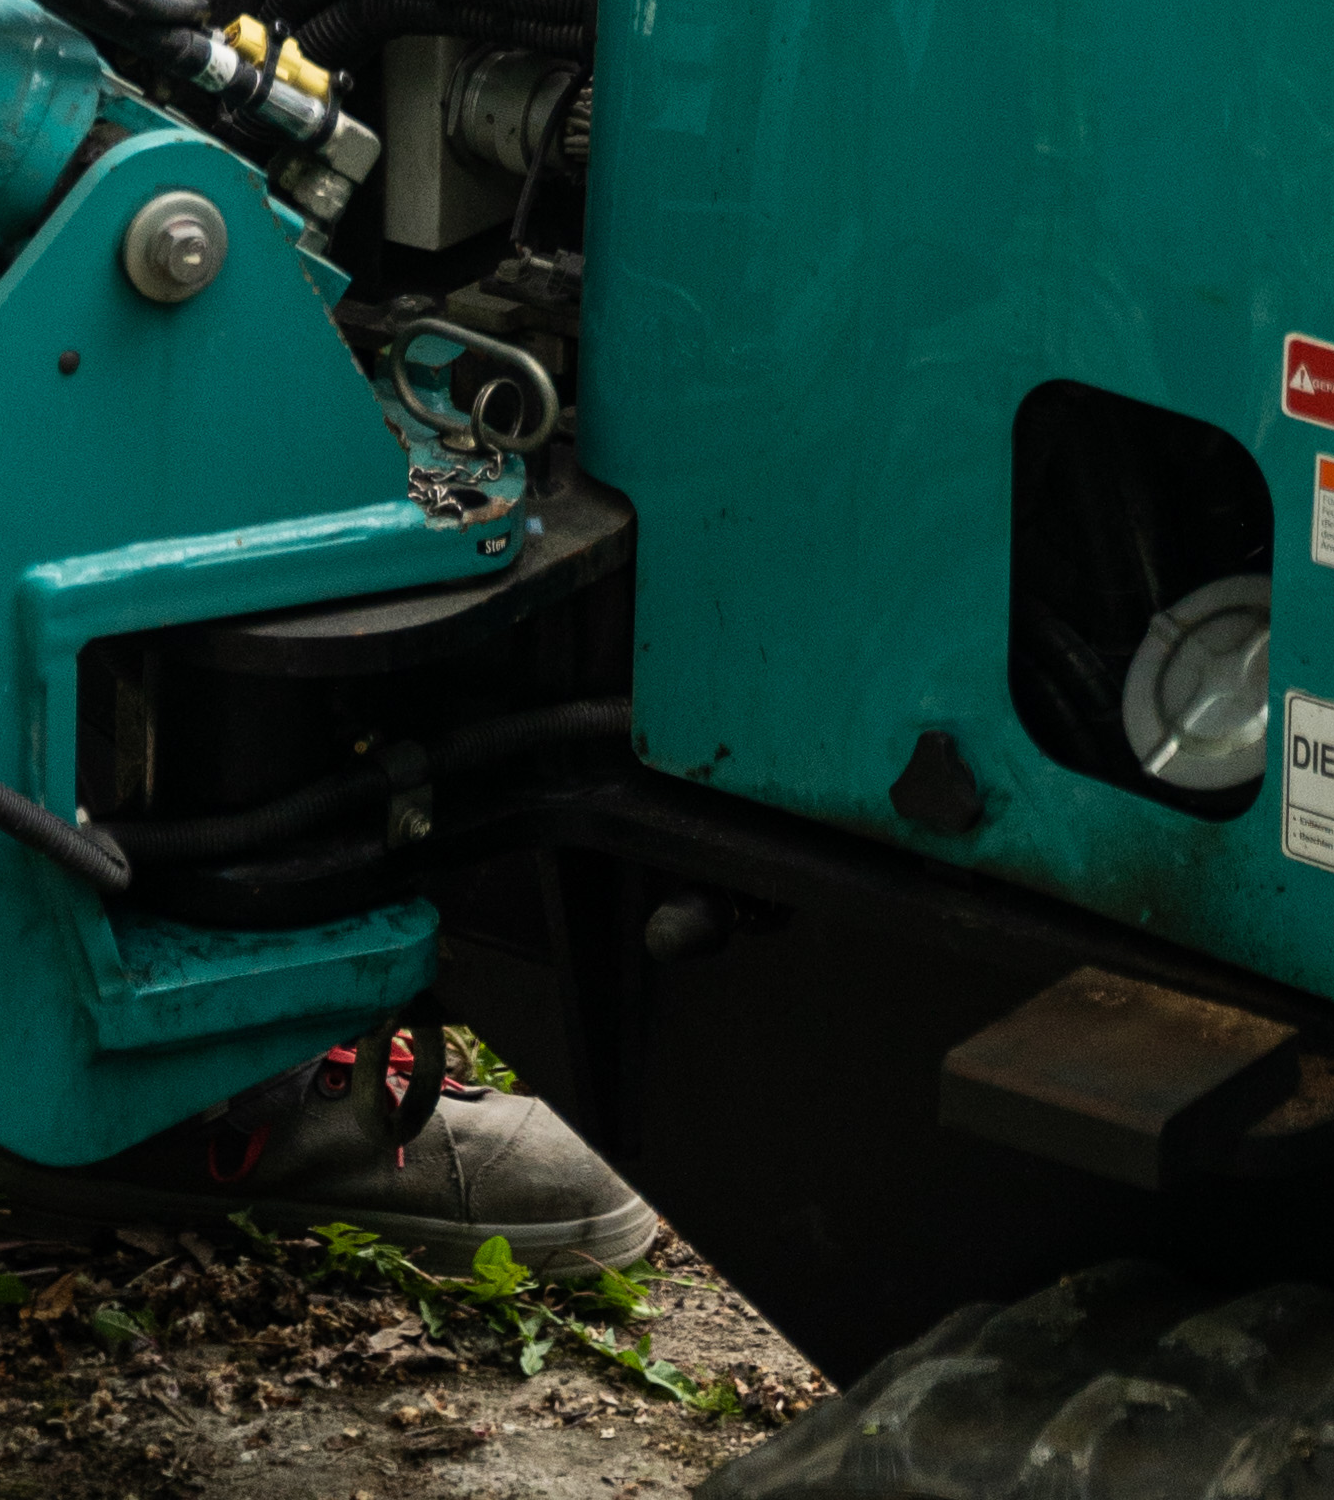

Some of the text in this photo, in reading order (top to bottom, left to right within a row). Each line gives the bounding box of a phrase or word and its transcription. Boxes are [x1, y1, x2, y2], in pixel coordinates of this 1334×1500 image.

[1321, 518, 1334, 529] die
[1321, 529, 1334, 542] des
[1299, 832, 1333, 851] Beachten
